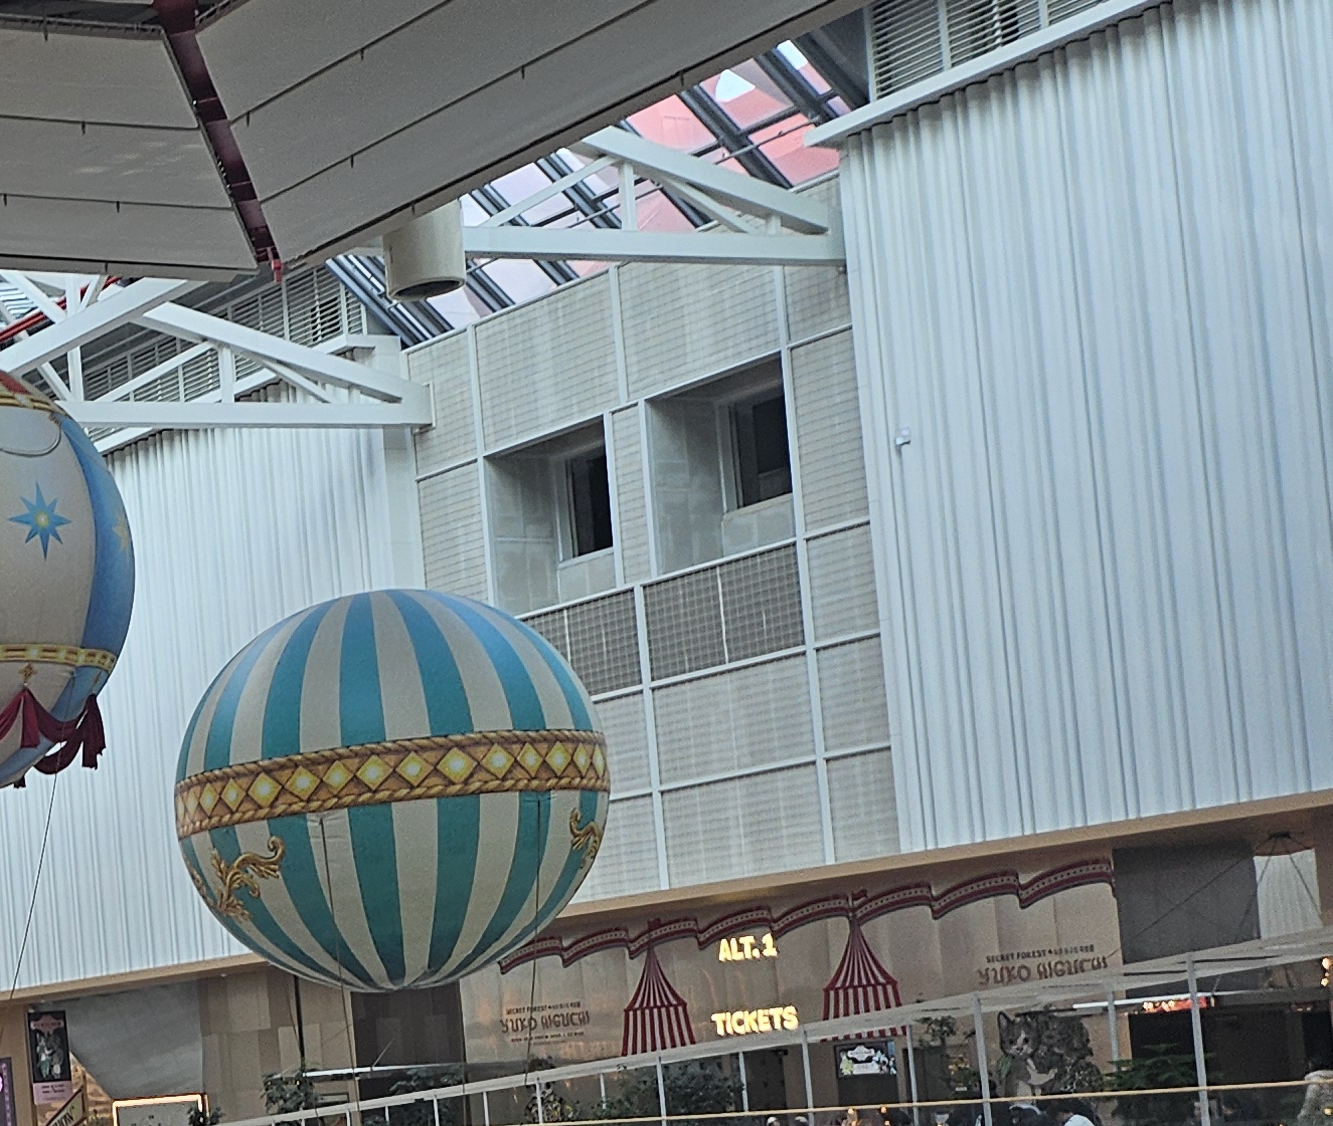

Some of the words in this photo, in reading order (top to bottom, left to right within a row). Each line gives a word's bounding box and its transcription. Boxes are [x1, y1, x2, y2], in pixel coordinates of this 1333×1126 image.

[718, 935, 761, 962] ALT.
[761, 932, 779, 958] 1
[1016, 949, 1047, 960] FOREST
[711, 1005, 799, 1036] TICKETS
